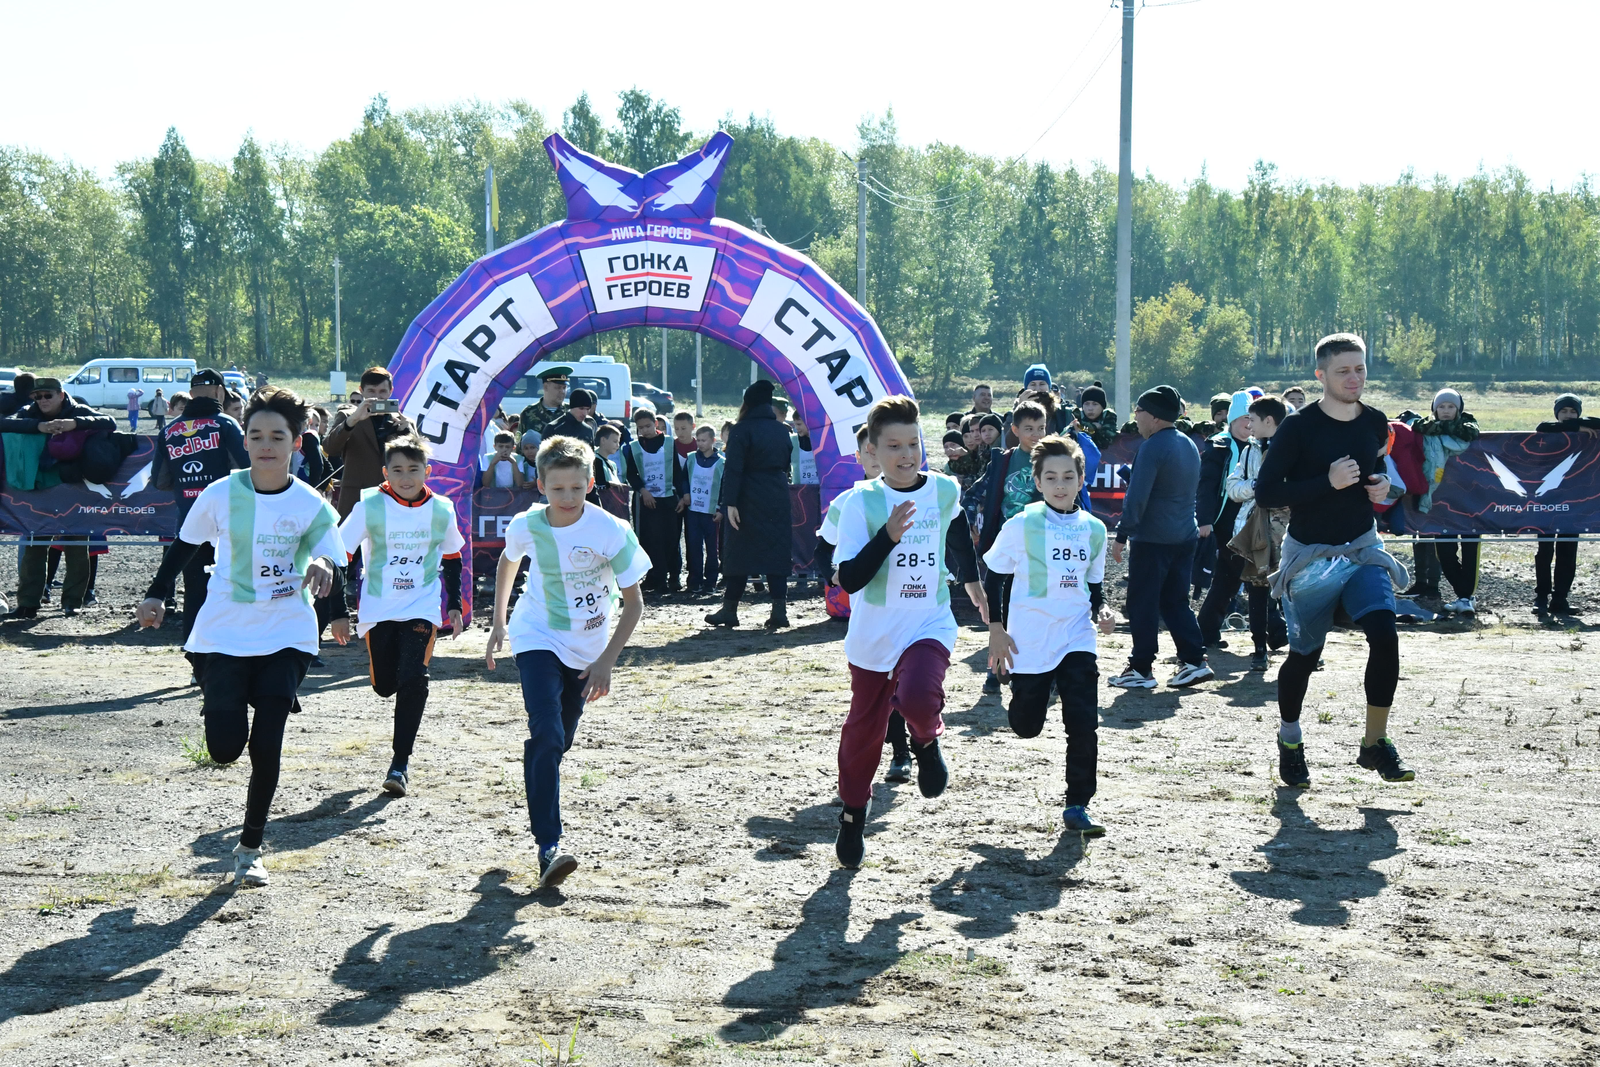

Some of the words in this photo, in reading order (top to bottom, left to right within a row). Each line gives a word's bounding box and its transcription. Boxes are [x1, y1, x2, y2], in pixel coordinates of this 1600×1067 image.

[611, 225, 645, 241] ЛИГА
[646, 224, 692, 240] ГЕРОЕВ
[607, 253, 688, 273] ГОНКА
[607, 280, 690, 300] ГЕРОЕВ
[416, 297, 522, 445] СТАРТ
[166, 437, 194, 460] Red
[192, 431, 220, 453] Bull
[179, 475, 213, 483] INFINITI
[646, 474, 664, 482] 29-2
[692, 487, 709, 495] 29-4
[78, 506, 109, 514] ЛИГА
[112, 506, 156, 514] ГЕРОЕВ
[1494, 504, 1523, 512] ЛИГА
[1526, 504, 1570, 512] ГЕРОЕВ
[394, 543, 421, 551] СТАРТ
[897, 552, 935, 567] 28-5
[1052, 548, 1087, 561] 28-6
[574, 585, 610, 608] 28-3
